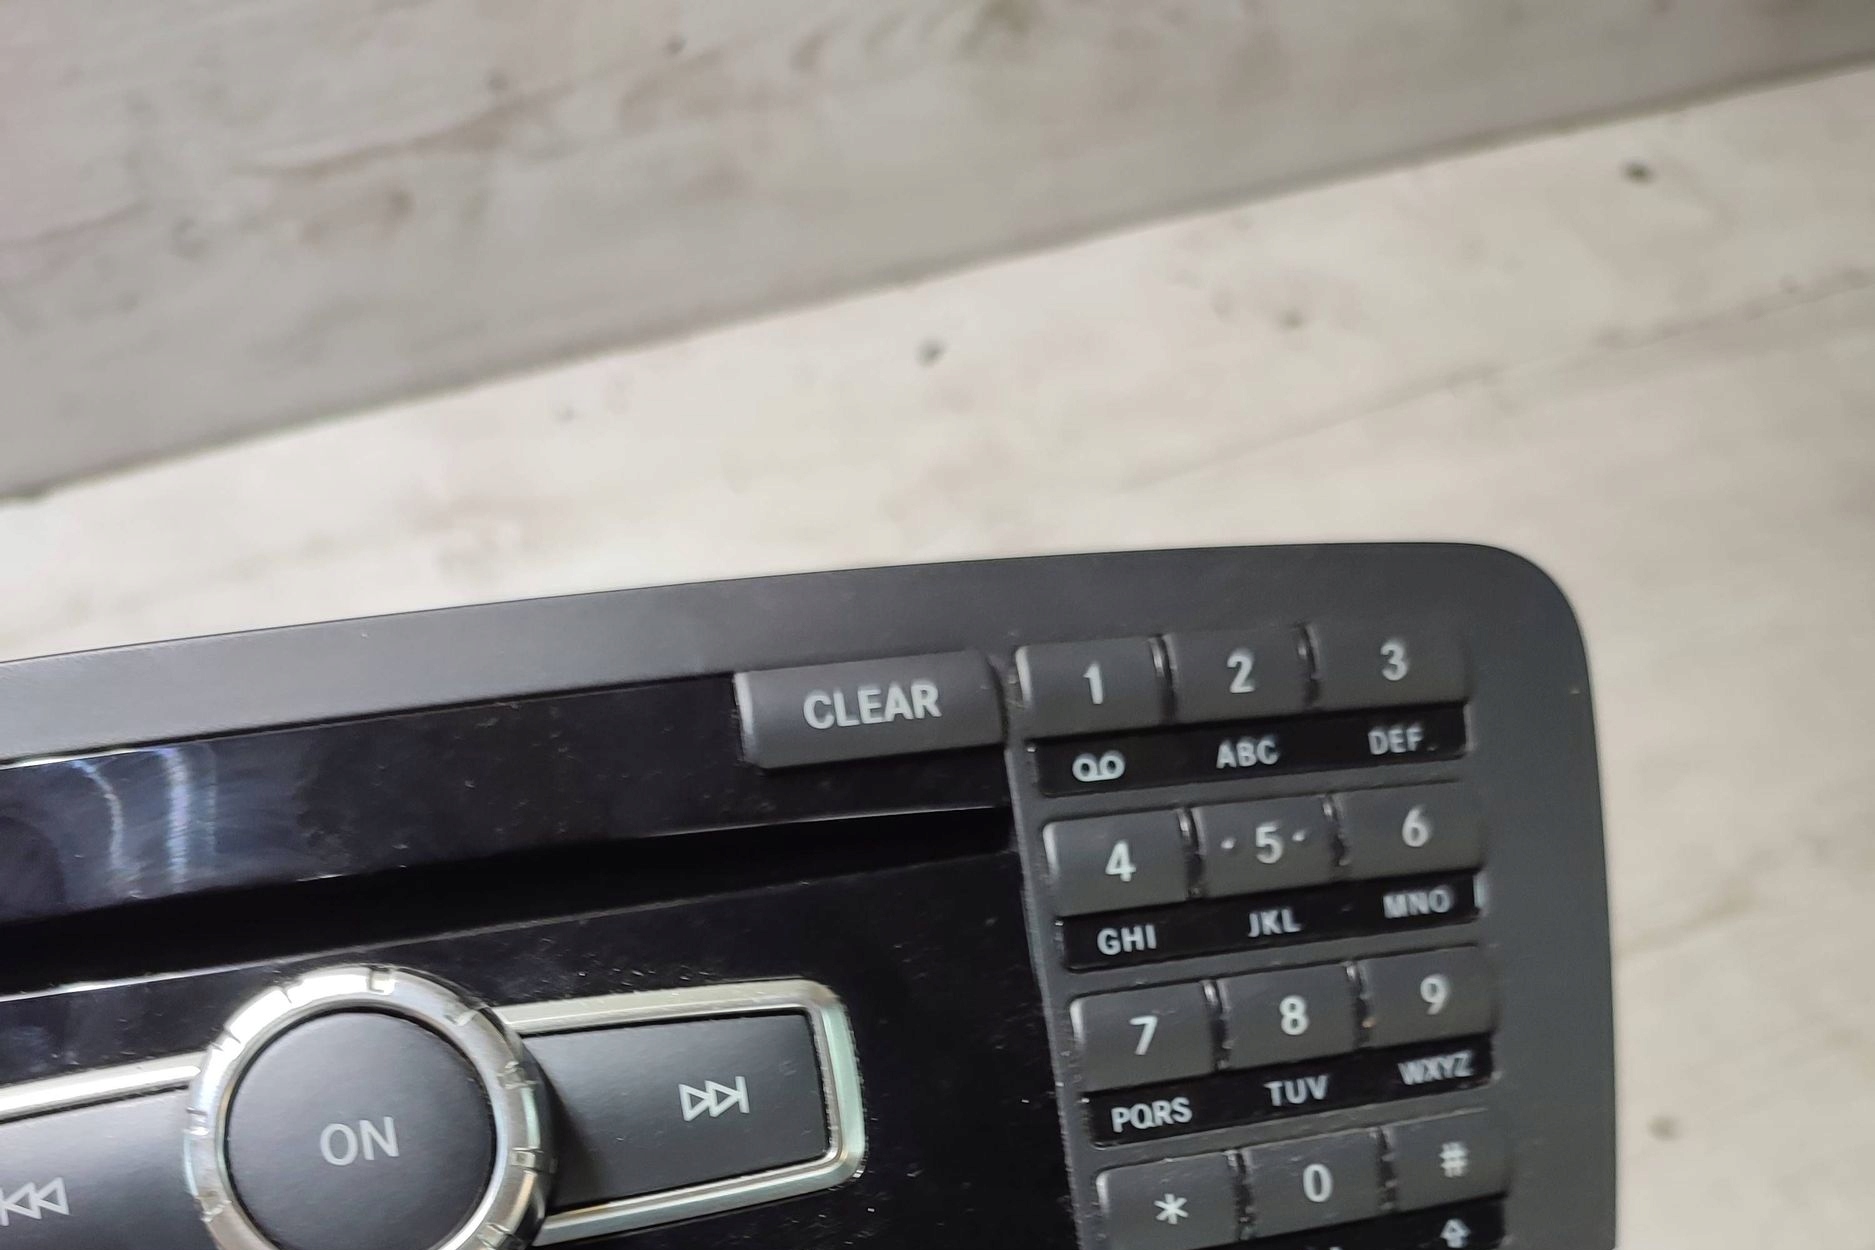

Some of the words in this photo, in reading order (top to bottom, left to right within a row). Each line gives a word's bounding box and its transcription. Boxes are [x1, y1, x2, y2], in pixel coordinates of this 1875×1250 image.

[1227, 650, 1253, 693] 2
[1380, 640, 1407, 680] 3
[1083, 663, 1102, 704] 1
[803, 679, 941, 728] CLEAR
[1216, 737, 1277, 768] ABC
[1367, 725, 1421, 754] DEF
[1255, 822, 1282, 863] 5
[1402, 808, 1428, 846] 6
[1105, 841, 1135, 881] 4
[1383, 887, 1450, 917] MNO
[1097, 924, 1156, 955] GHI
[1248, 908, 1300, 937] JKL
[1420, 975, 1447, 1013] 9
[1279, 995, 1307, 1034] 8
[1130, 1015, 1157, 1054] 7
[1398, 1050, 1471, 1084] WXYZ
[1264, 1074, 1327, 1106] TUV
[1112, 1097, 1193, 1133] PQRS
[319, 1116, 398, 1165] ON
[1303, 1163, 1331, 1202] 0
